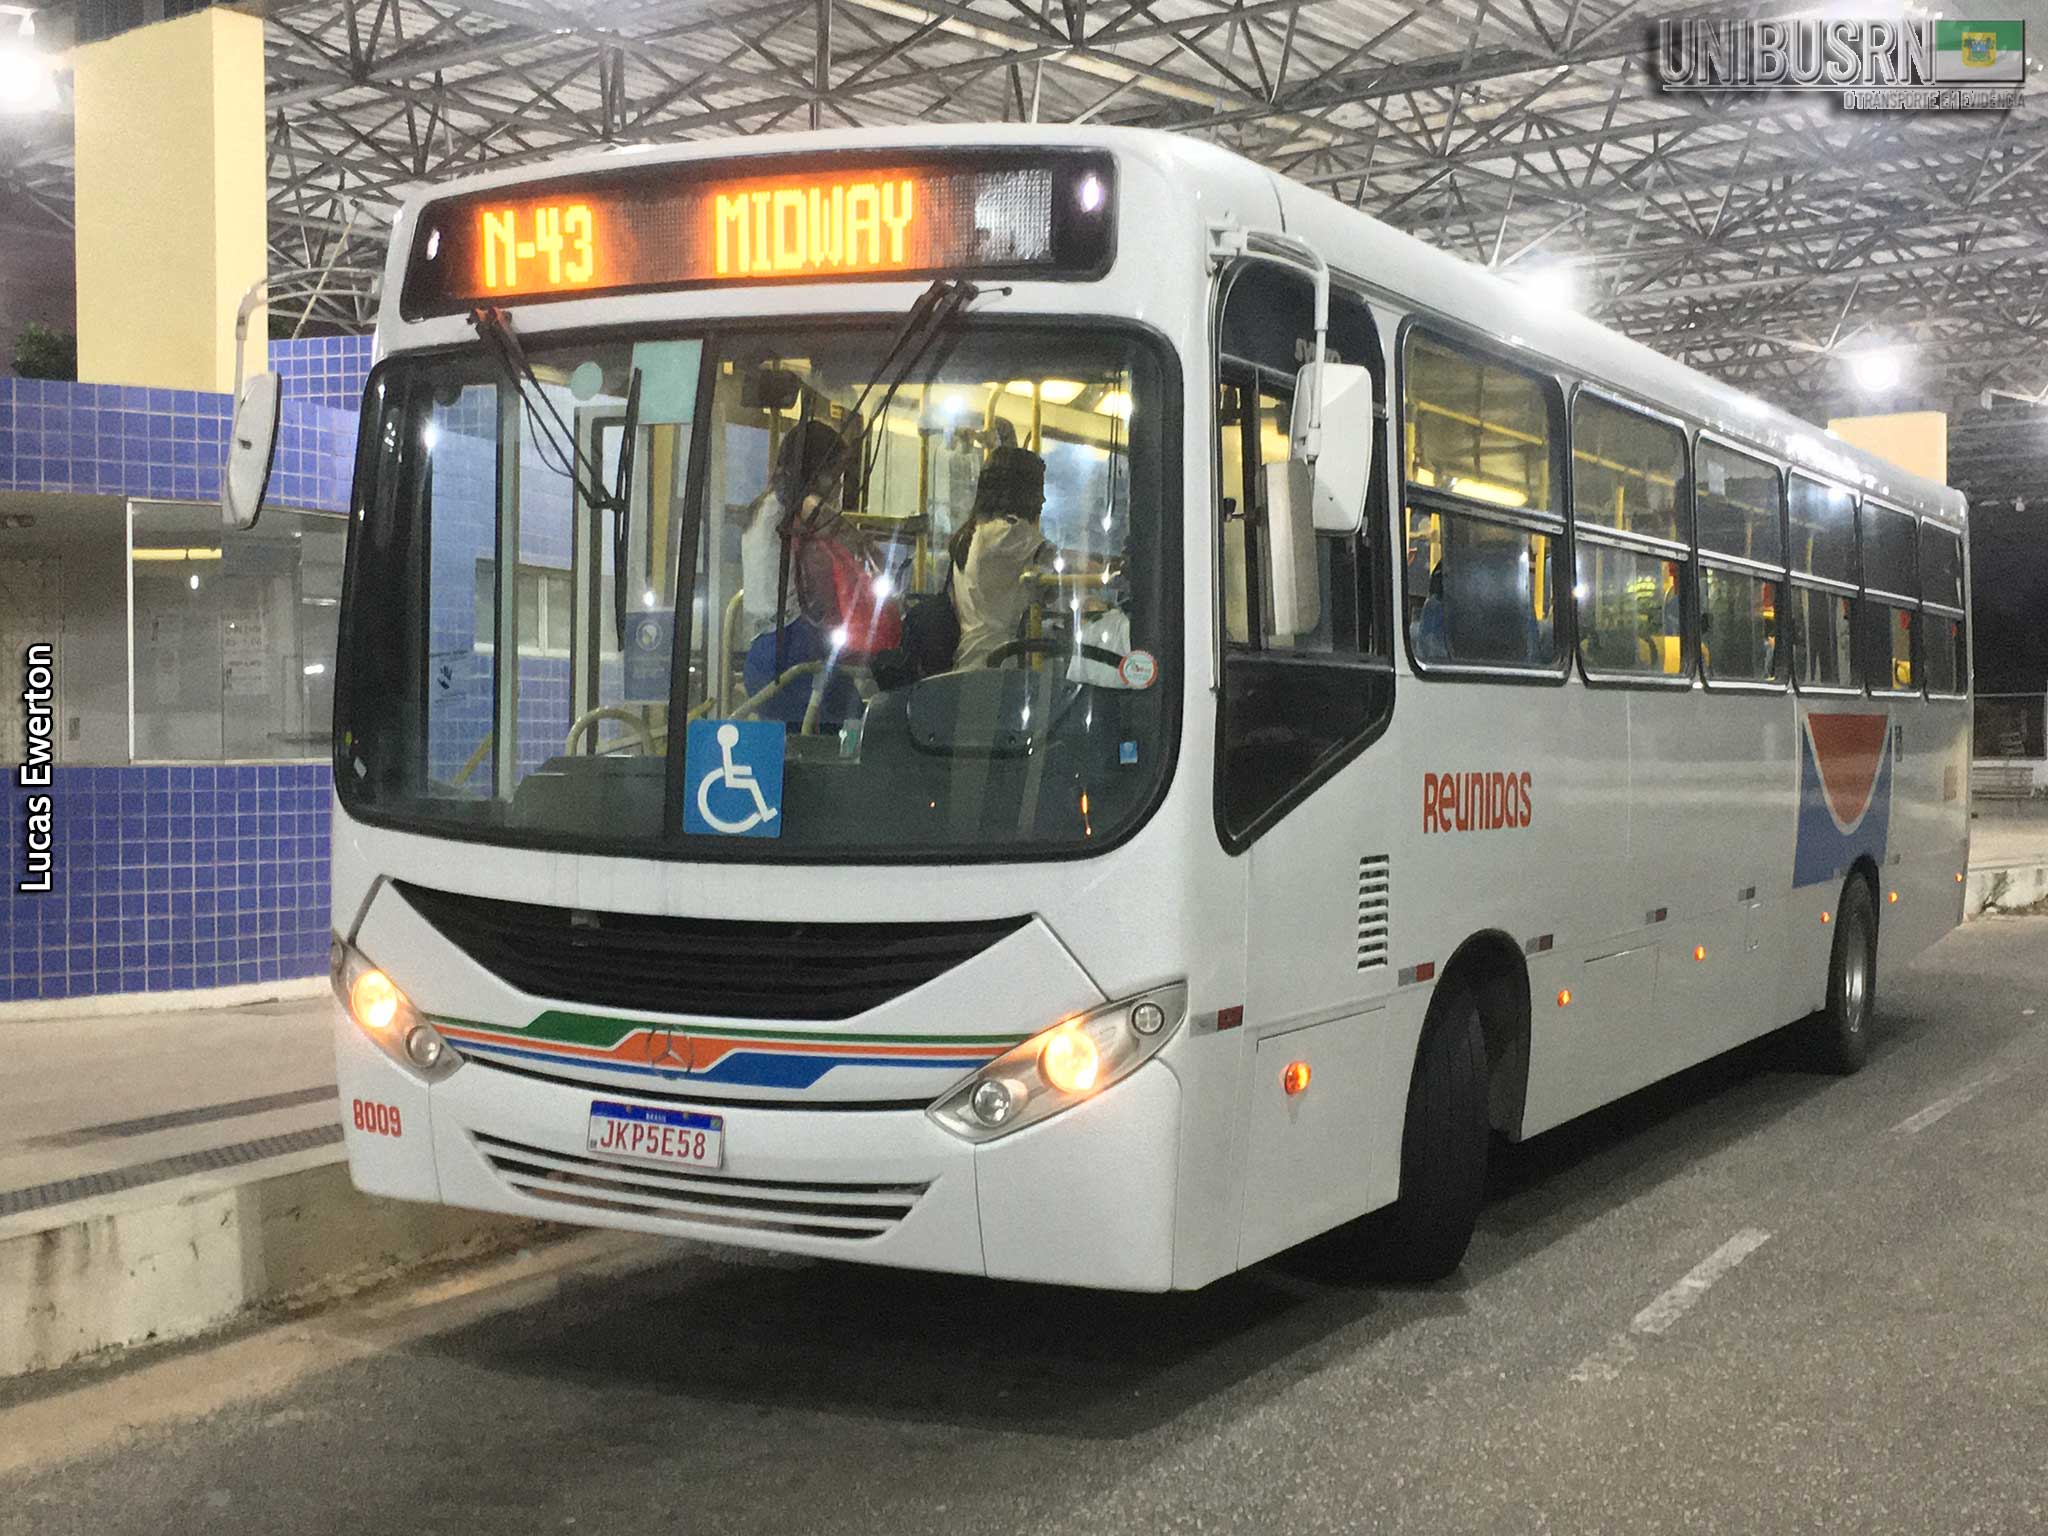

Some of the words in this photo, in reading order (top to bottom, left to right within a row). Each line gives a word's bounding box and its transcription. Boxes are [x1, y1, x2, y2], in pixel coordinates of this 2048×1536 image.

[483, 205, 593, 288] N-43
[715, 180, 913, 274] MIDWAY
[353, 1099, 402, 1138] 8009
[600, 1120, 706, 1160] JKP5E58
